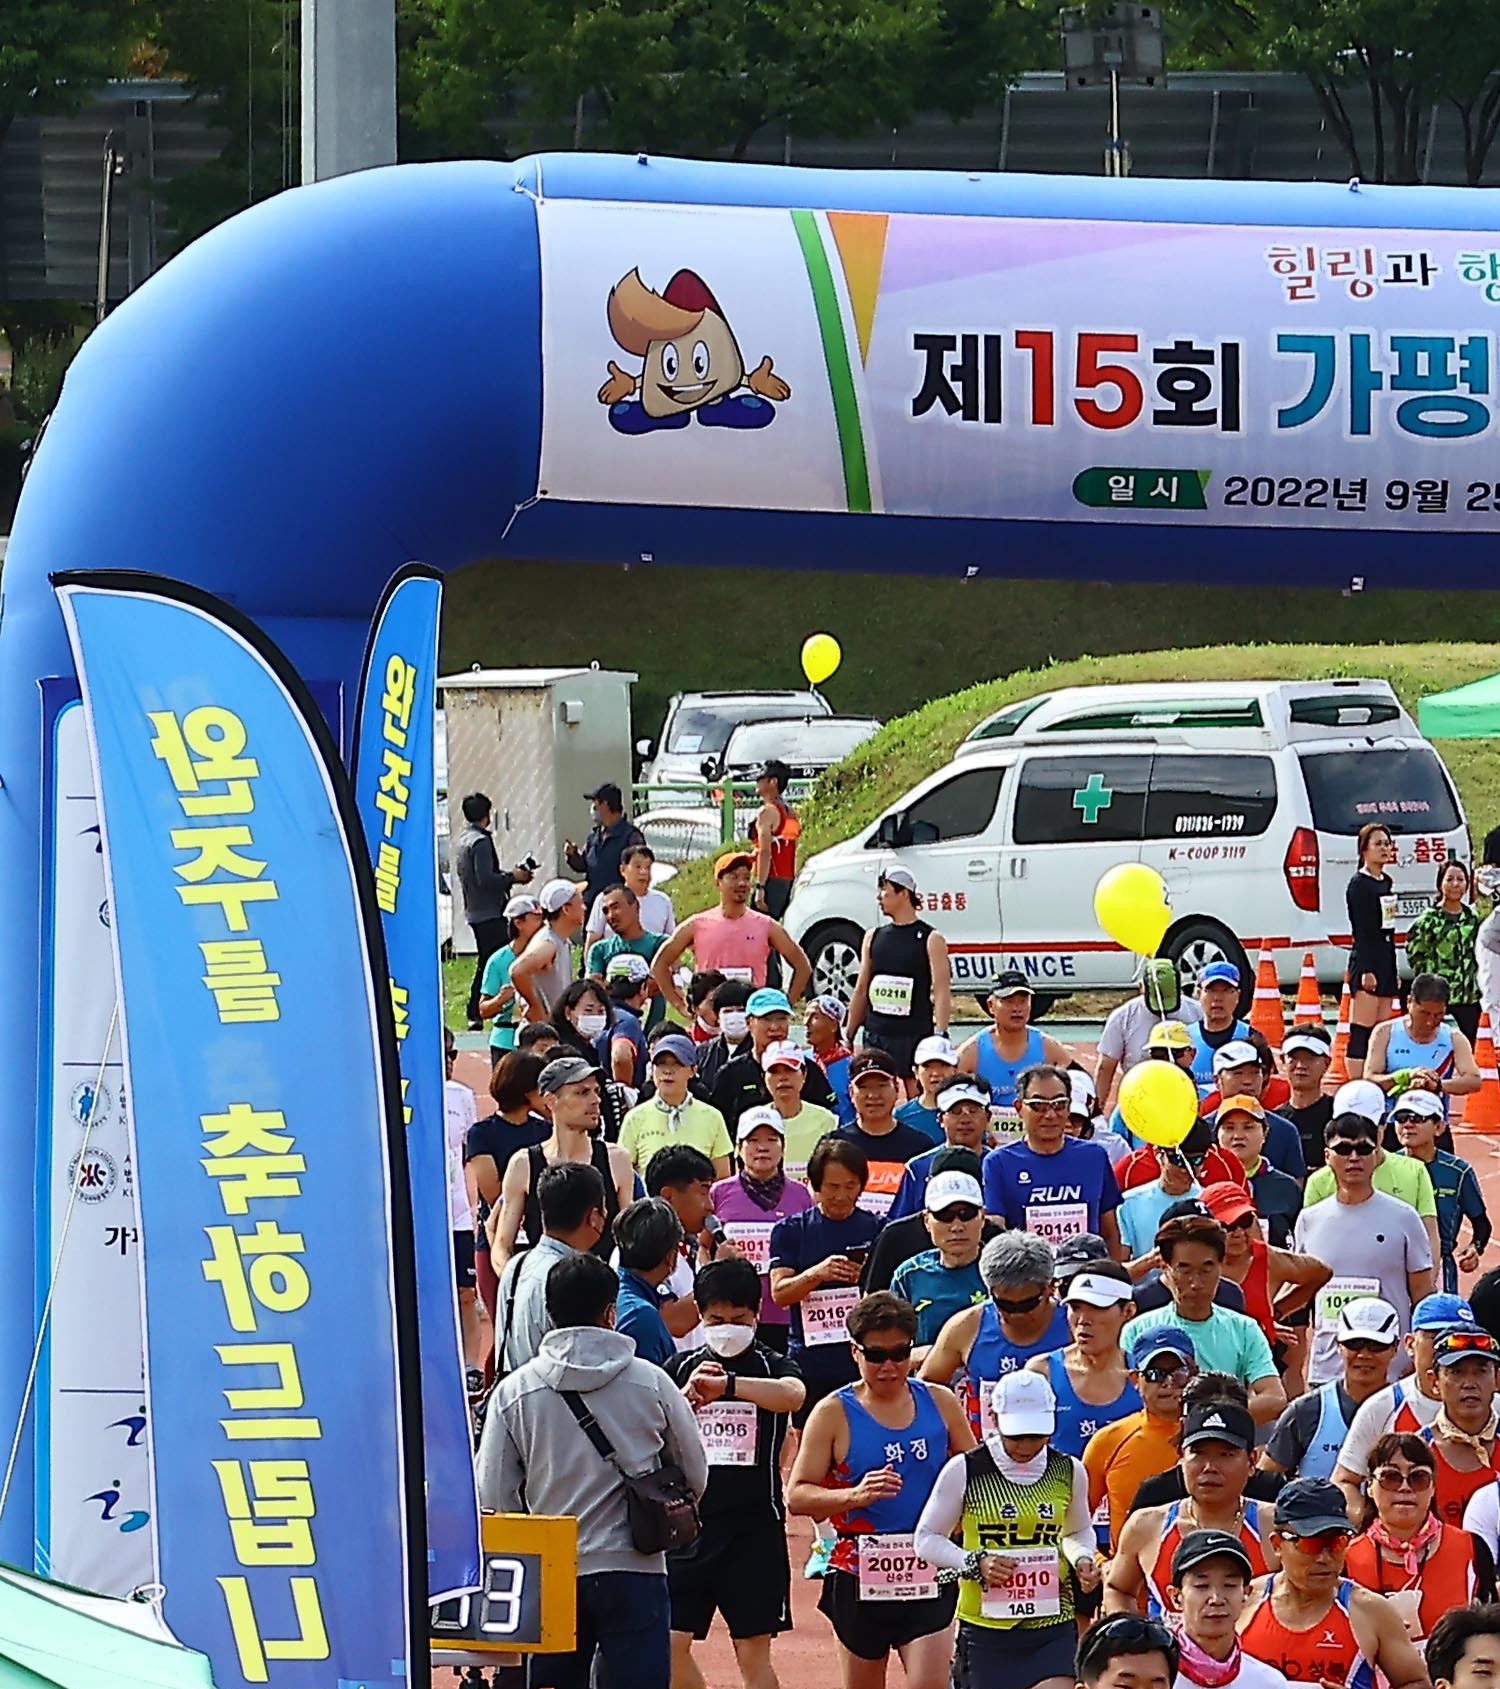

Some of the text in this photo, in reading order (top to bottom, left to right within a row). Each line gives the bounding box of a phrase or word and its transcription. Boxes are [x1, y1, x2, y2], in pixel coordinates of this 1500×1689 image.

[1268, 247, 1438, 301] 힐링과
[912, 329, 1240, 433] 제15회
[1223, 476, 1368, 512] 2022년
[1385, 479, 1449, 514] 9월
[374, 655, 417, 914] 완주를
[1029, 1185, 1081, 1203] RUN
[883, 1438, 928, 1463] 화정
[867, 1556, 929, 1573] 20078
[1008, 1602, 1036, 1616] 1AB
